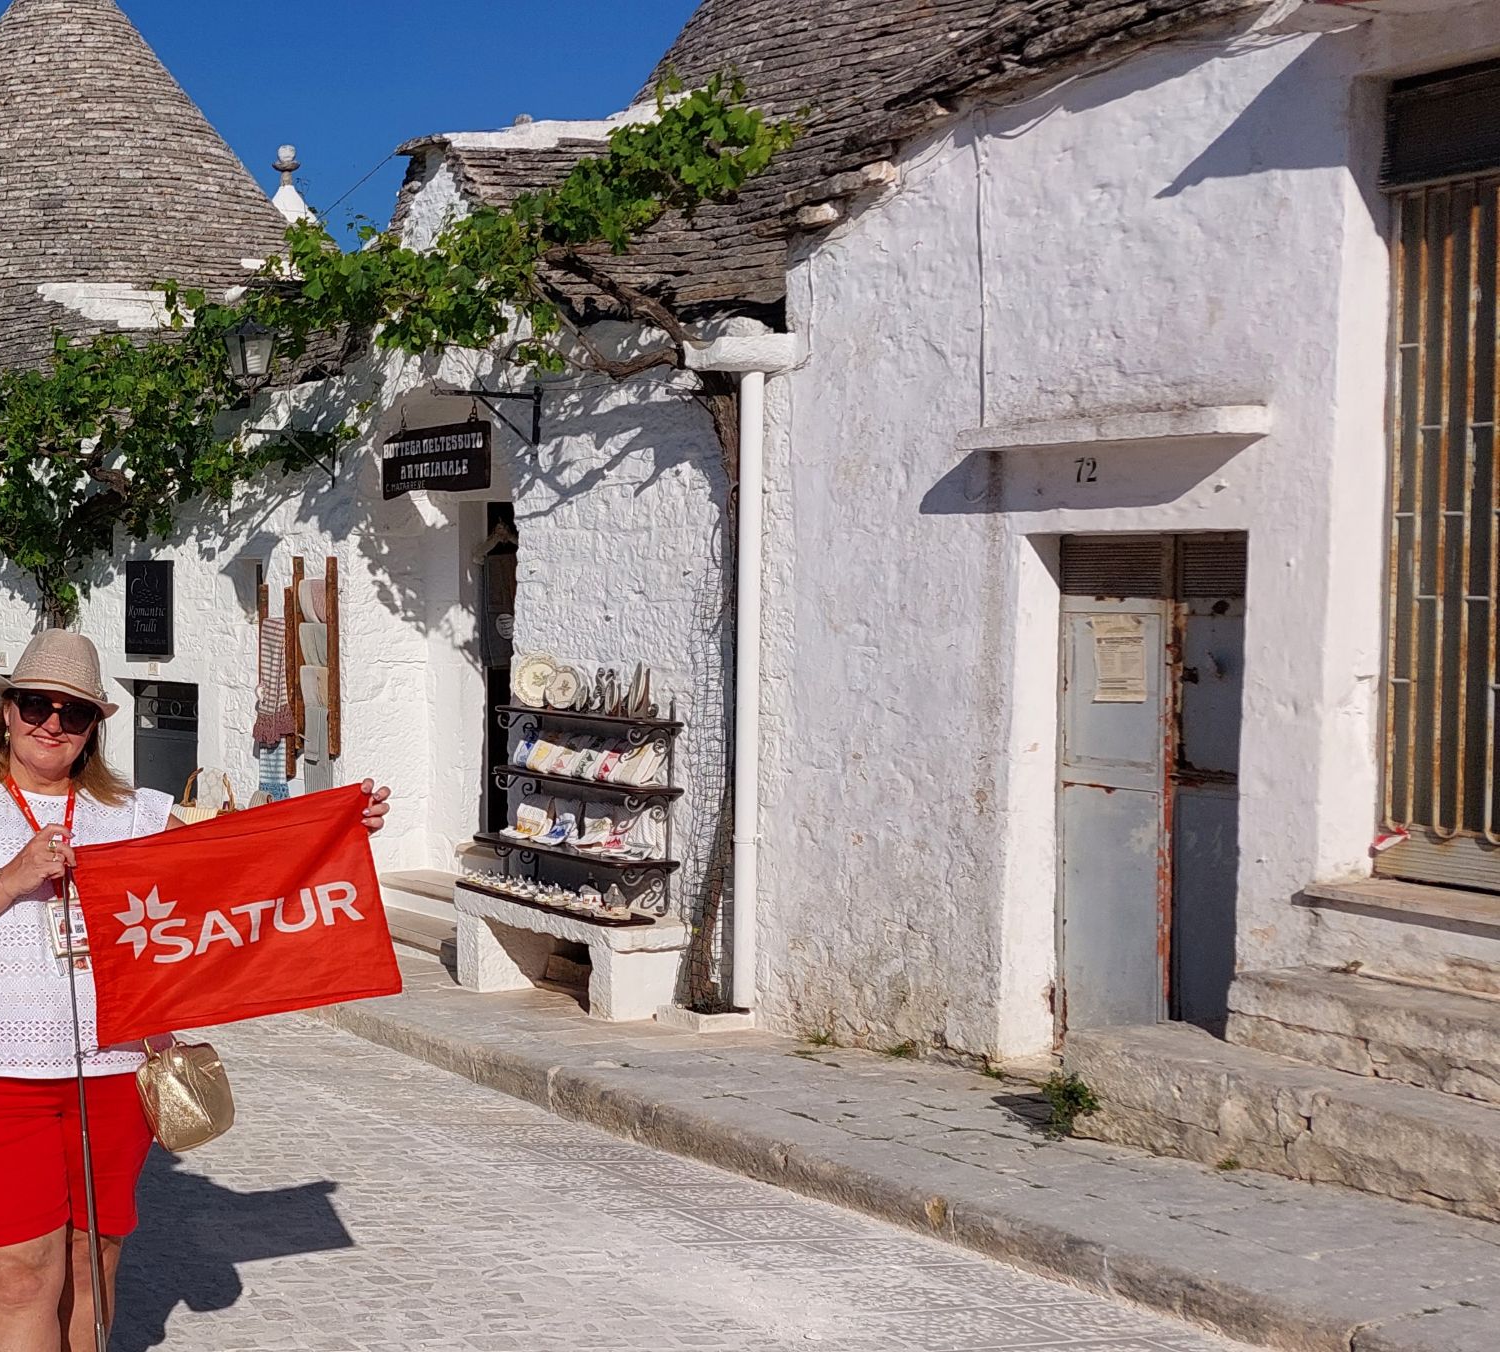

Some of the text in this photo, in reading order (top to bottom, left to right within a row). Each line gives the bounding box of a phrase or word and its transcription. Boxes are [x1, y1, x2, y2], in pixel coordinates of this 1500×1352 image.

[383, 432, 483, 459] BOTTEGA DEL TESSUTO
[400, 459, 468, 480] ARTIGIANALE
[1074, 457, 1097, 483] 72
[128, 605, 166, 618] Romantic
[133, 618, 157, 632] Trulli
[150, 881, 365, 963] SATUR
